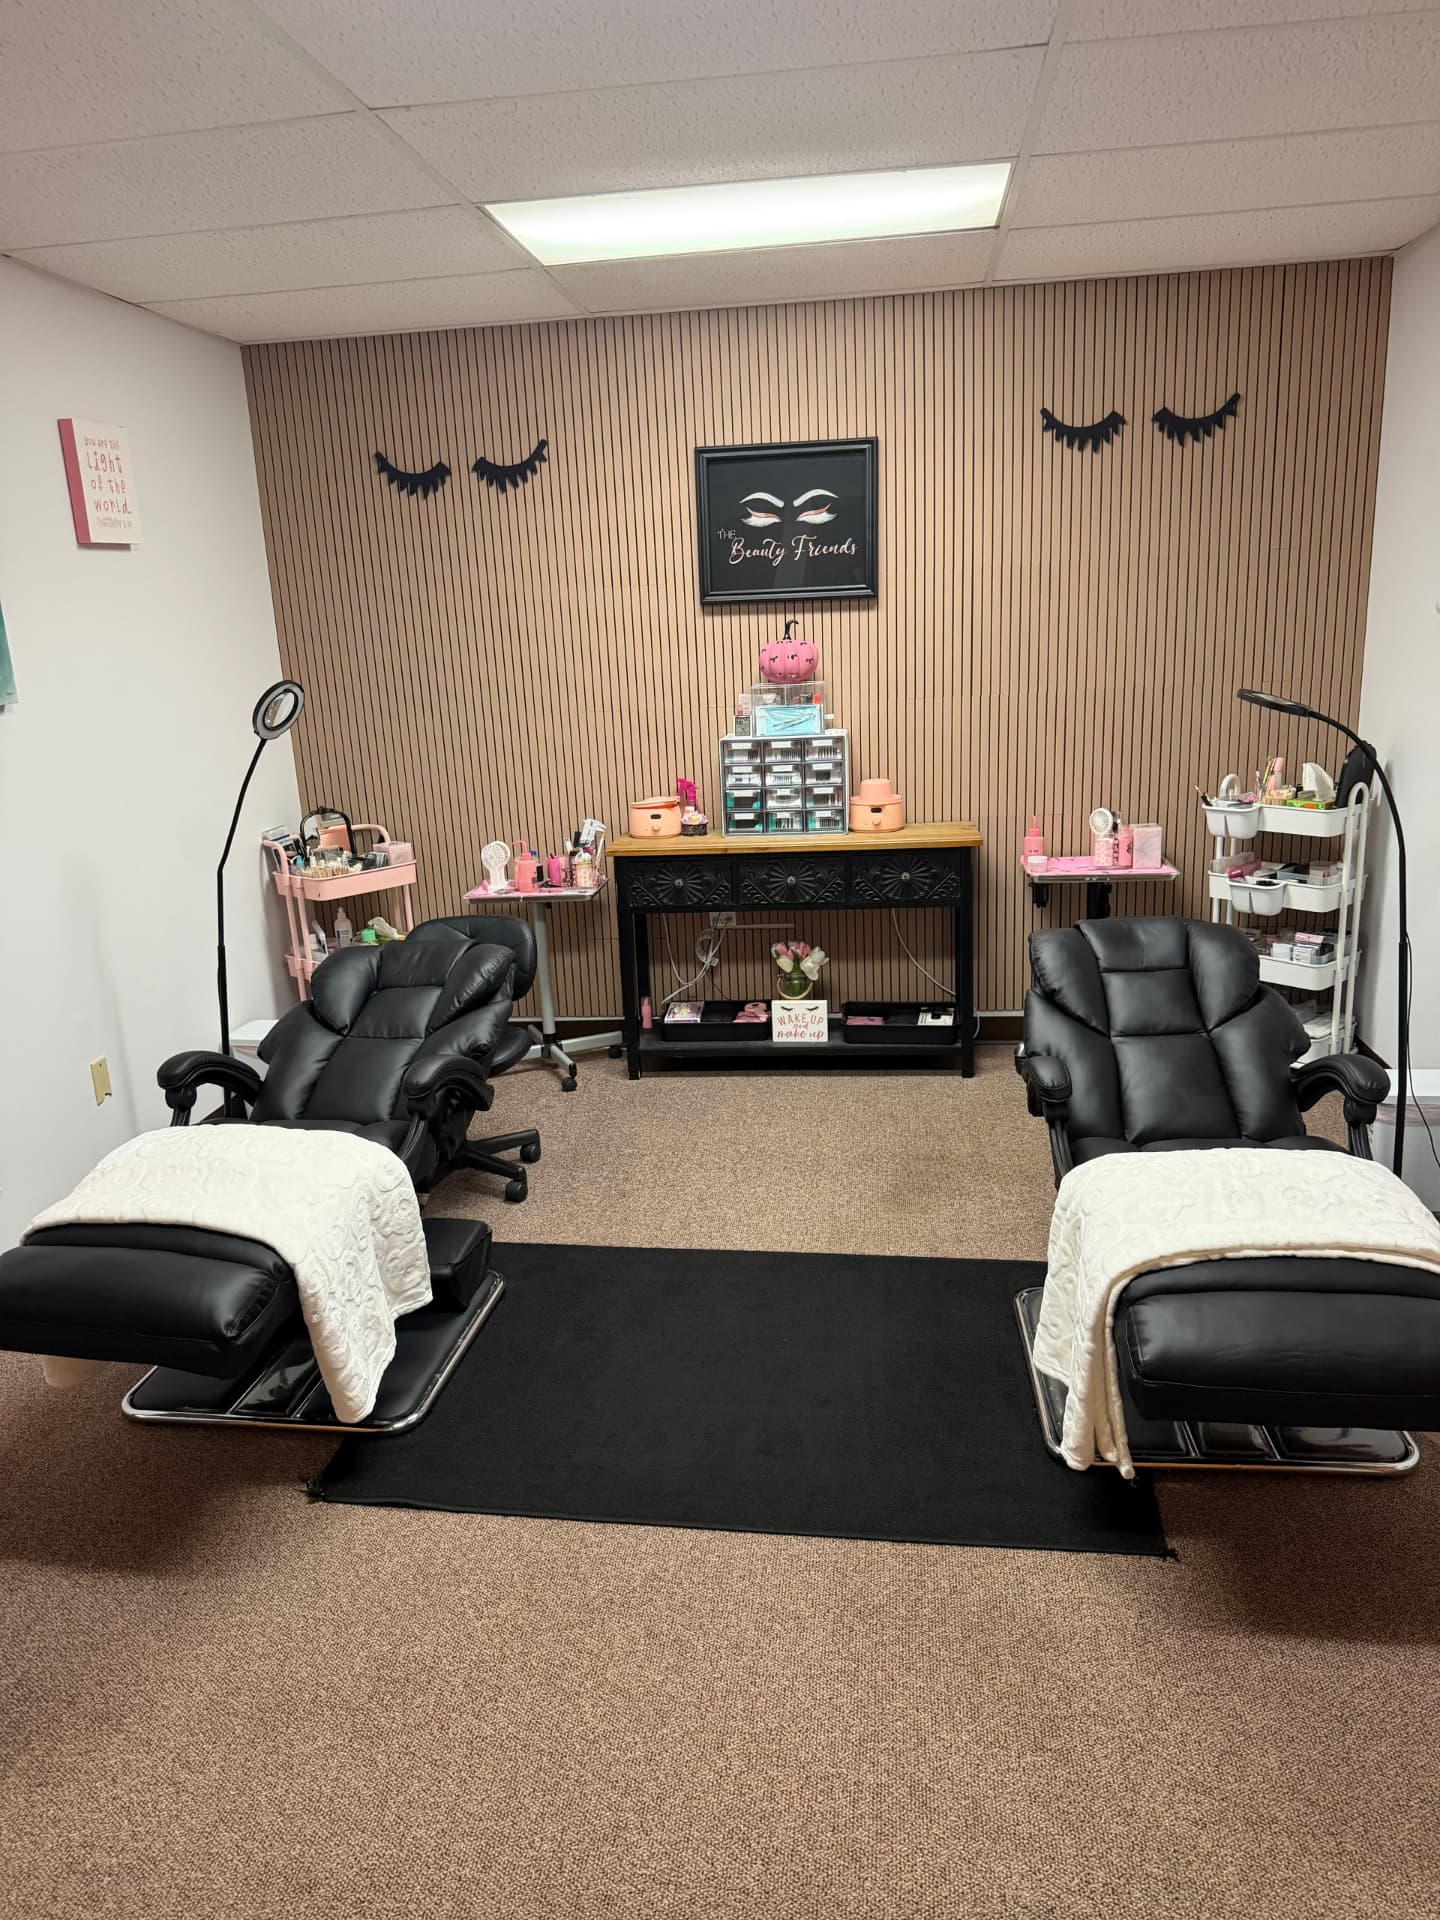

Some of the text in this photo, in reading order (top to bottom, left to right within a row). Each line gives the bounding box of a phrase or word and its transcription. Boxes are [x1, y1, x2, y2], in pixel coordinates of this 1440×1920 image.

[108, 476, 126, 494] the
[717, 528, 737, 540] THE
[728, 534, 858, 567] Beauty Friends
[777, 1012, 824, 1026] WAKE UP
